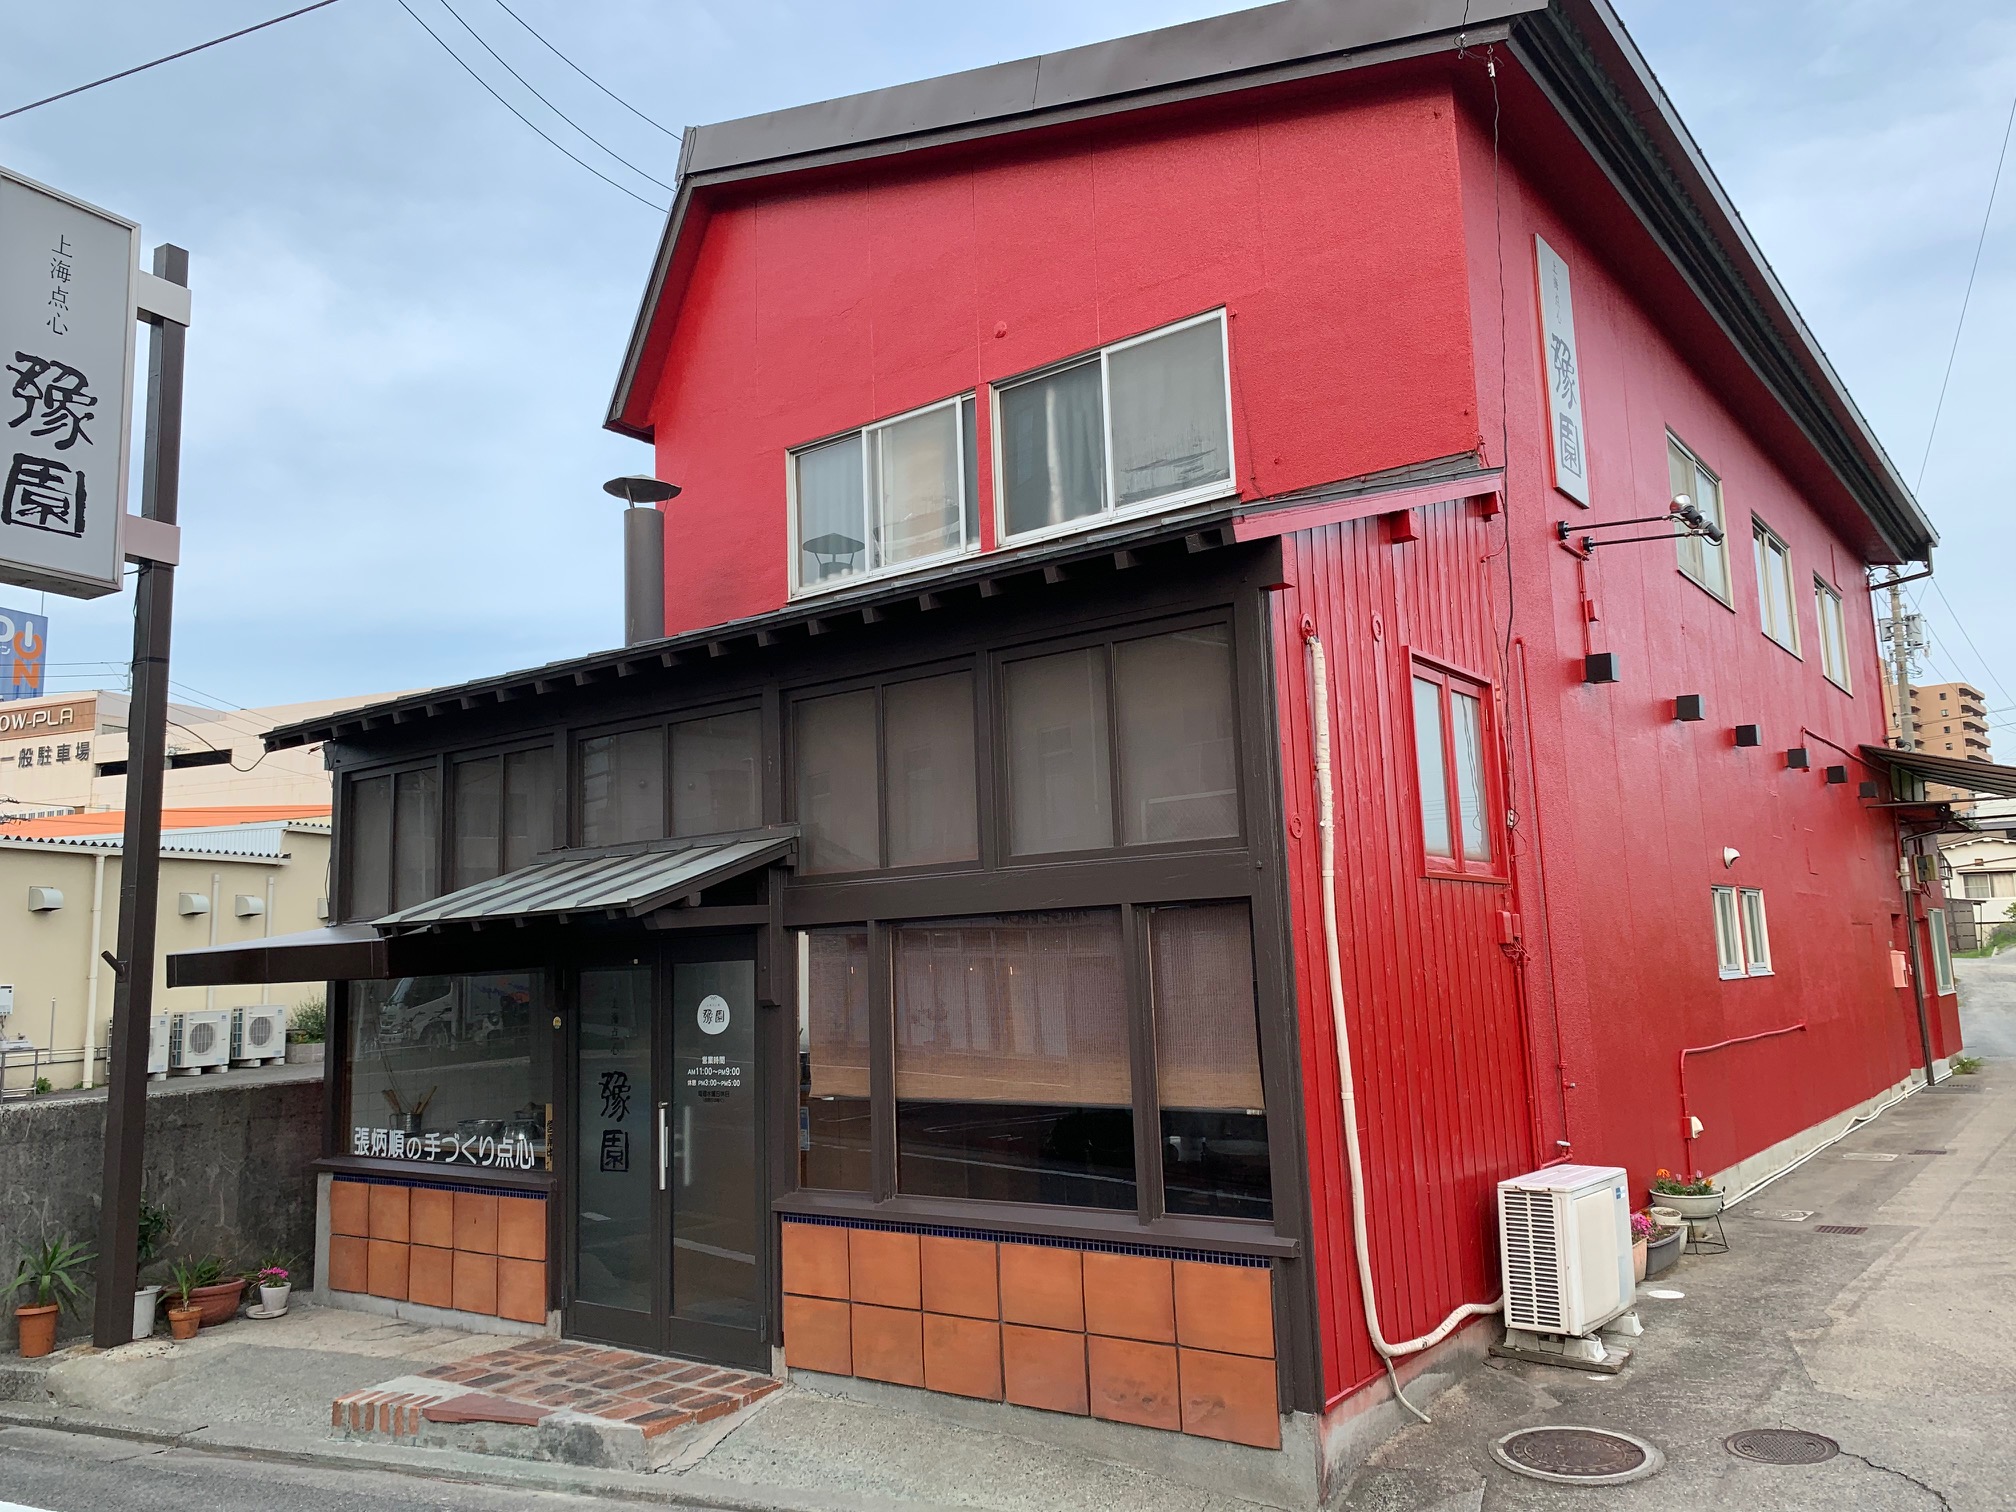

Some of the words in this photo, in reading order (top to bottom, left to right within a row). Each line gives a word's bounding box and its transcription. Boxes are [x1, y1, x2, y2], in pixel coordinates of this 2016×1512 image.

[46, 233, 73, 336] 上海点心
[1, 350, 98, 538] 豫園
[0, 741, 90, 768] 一般駐車場
[354, 1127, 535, 1170] 張炳順の手づくり点心
